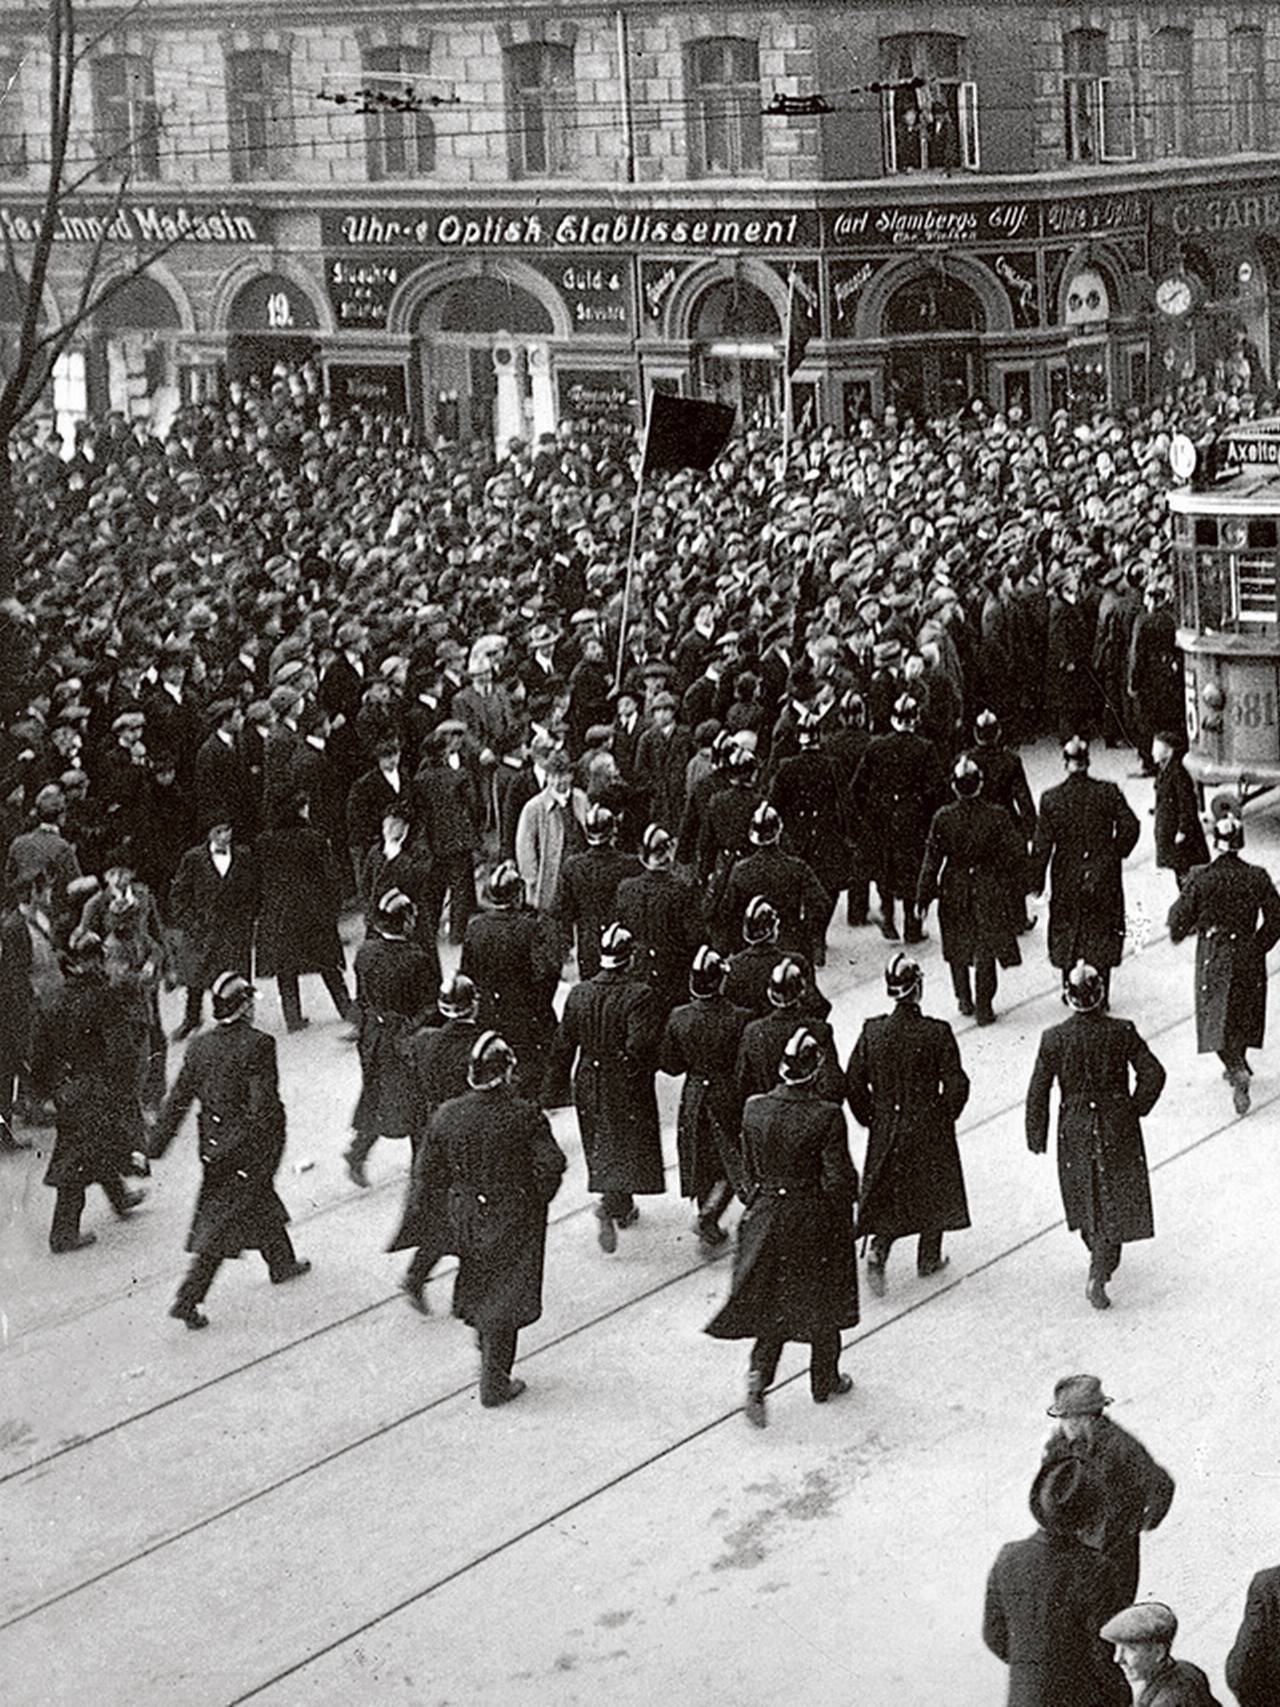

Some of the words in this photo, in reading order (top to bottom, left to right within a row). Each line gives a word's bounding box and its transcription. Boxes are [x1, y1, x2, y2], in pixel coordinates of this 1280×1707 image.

[554, 213, 799, 244] Etablissement
[833, 209, 869, 243] Carl
[563, 266, 602, 290] Guld
